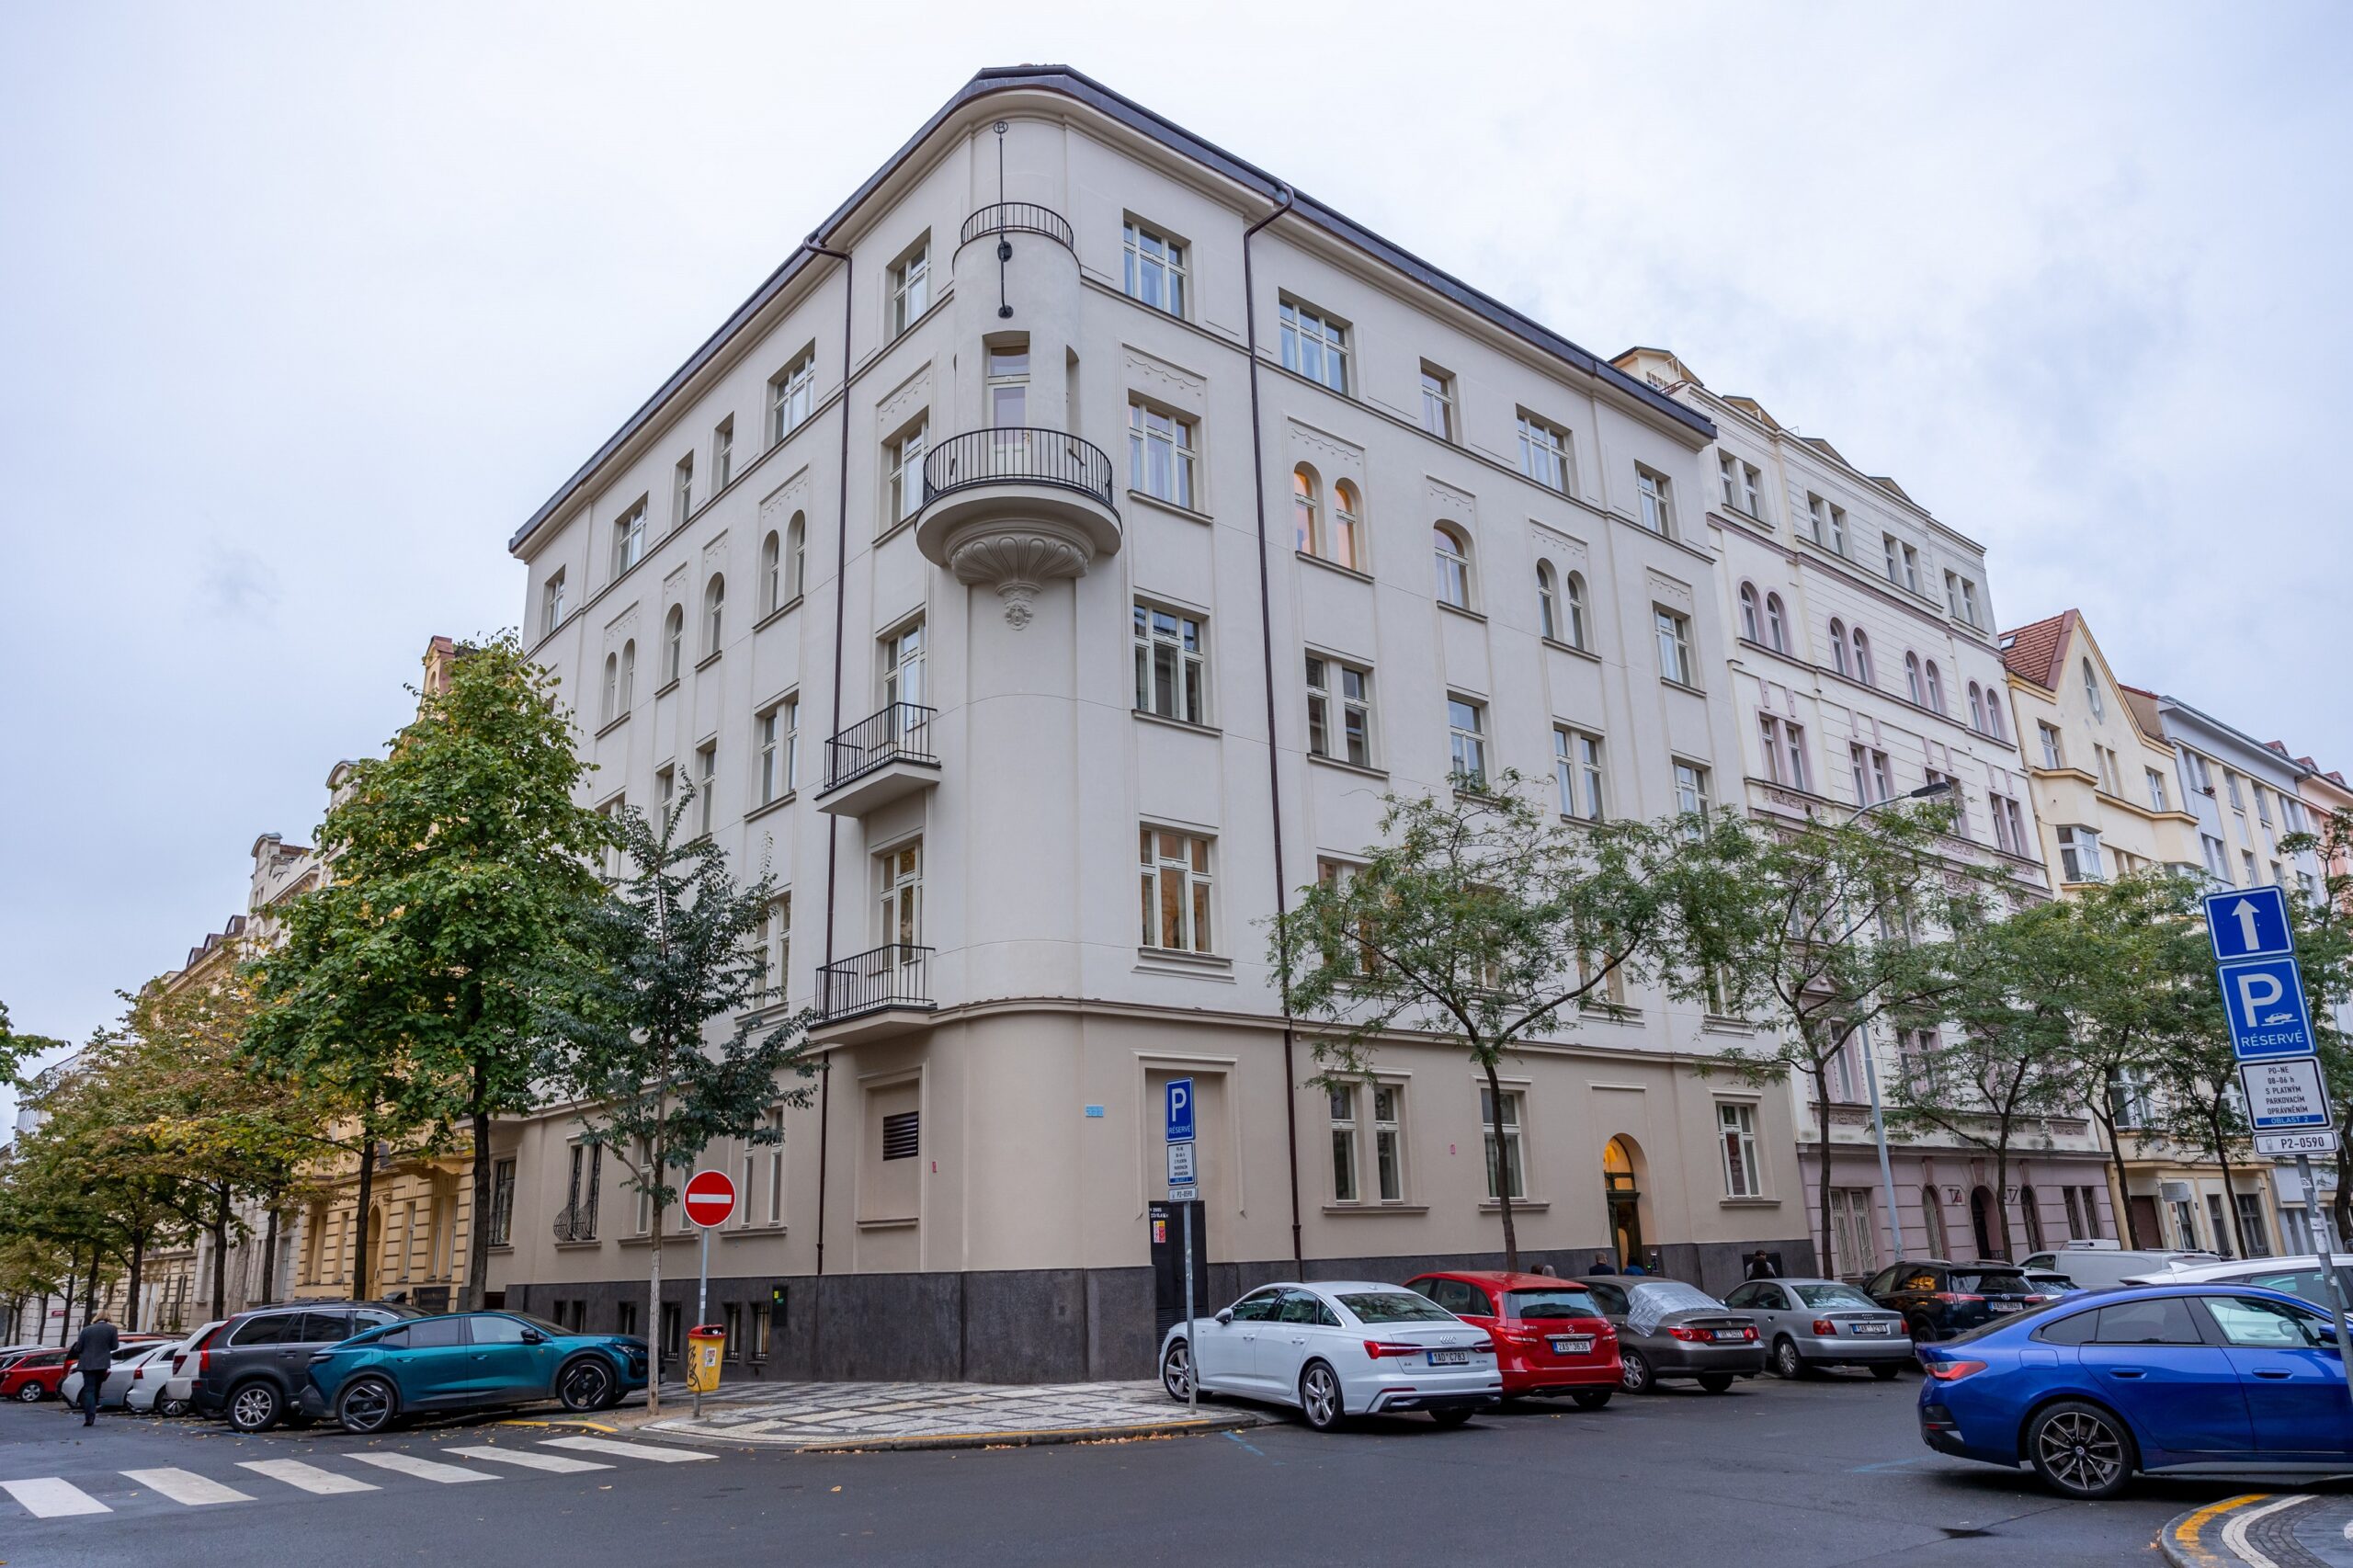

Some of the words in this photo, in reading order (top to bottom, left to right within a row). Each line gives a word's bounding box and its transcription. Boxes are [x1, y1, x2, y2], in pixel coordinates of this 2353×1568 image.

[2237, 973, 2283, 1028] P
[2241, 1029, 2304, 1048] RÉSERVÉ
[2268, 1066, 2290, 1074] PO-NE
[2268, 1076, 2288, 1085] 08-06
[2272, 1085, 2302, 1095] PLATNÝM
[1172, 1087, 1187, 1122] P
[2266, 1095, 2305, 1105] PARKOVACÍM
[2267, 1105, 2308, 1115] OPRÁVNĚNÍM
[1168, 1123, 1191, 1134] RÉSERVÉ
[2280, 1136, 2325, 1149] P2-0590
